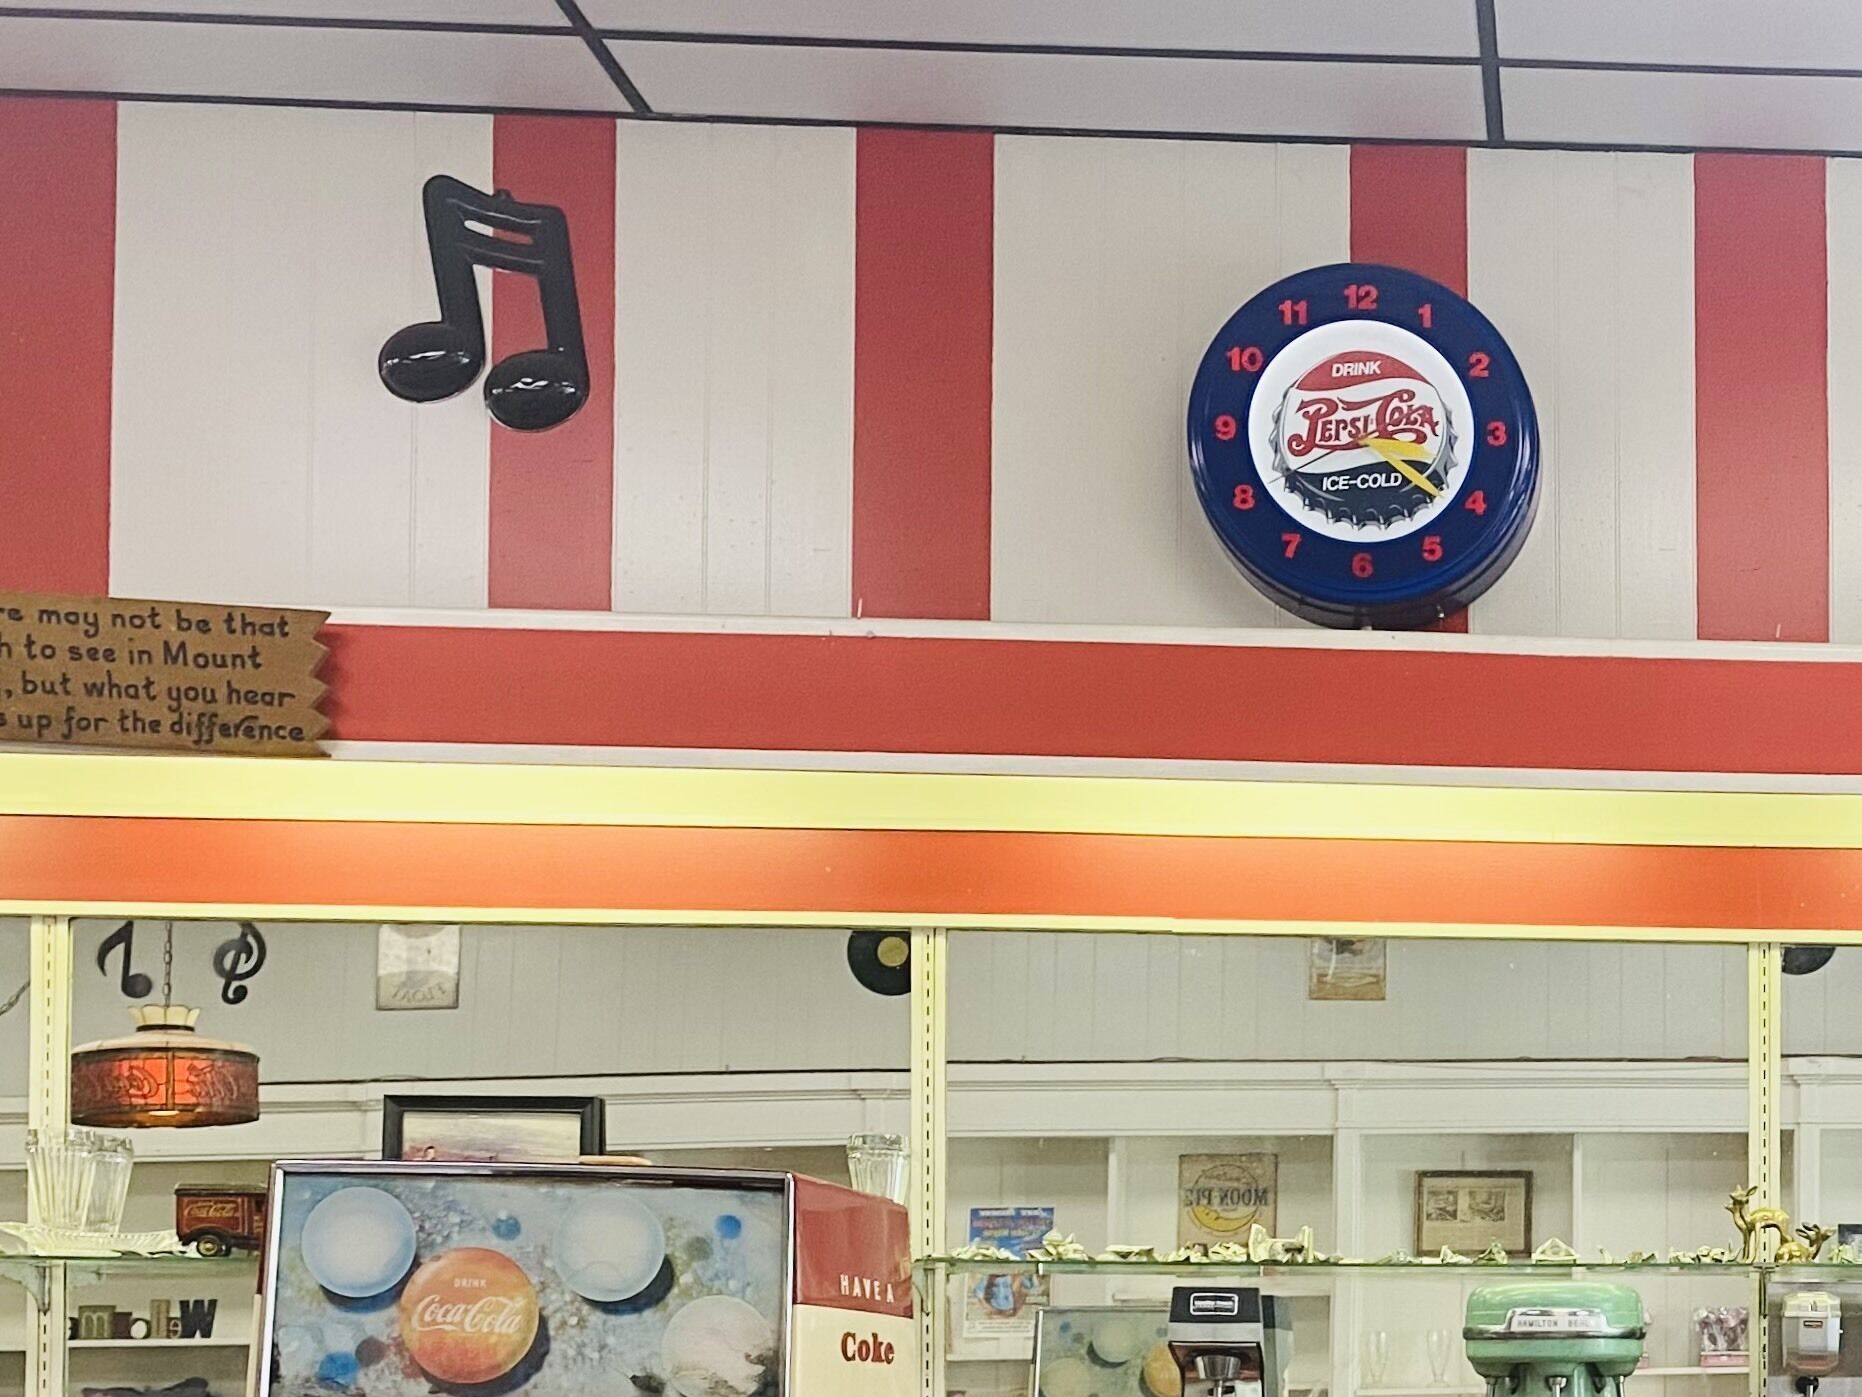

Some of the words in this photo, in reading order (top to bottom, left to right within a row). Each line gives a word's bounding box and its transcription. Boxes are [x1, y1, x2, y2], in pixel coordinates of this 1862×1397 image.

[1344, 284, 1378, 310] 12
[1279, 300, 1307, 325] 11
[1418, 304, 1433, 328] 1
[1227, 347, 1264, 371] 10
[1331, 361, 1381, 377] DRINK
[1468, 353, 1490, 378] 2
[1214, 415, 1237, 440] 9
[1487, 422, 1508, 446] 3
[1322, 473, 1402, 491] ICE-COLD
[1233, 484, 1255, 510] 8
[1464, 491, 1486, 515] 4
[1281, 534, 1302, 558] 7
[1421, 536, 1443, 561] 5
[1352, 553, 1374, 578] 6
[38, 609, 99, 639] may
[111, 606, 161, 629] not
[176, 609, 212, 632] be
[223, 612, 289, 637] that
[24, 633, 56, 660] to
[68, 645, 117, 663] see
[128, 638, 152, 665] in
[163, 640, 262, 669] Mount
[22, 670, 72, 696] but
[83, 670, 156, 700] what
[168, 686, 217, 713] you
[227, 680, 296, 708] hear
[17, 714, 51, 738] up
[62, 705, 110, 740] for
[119, 709, 161, 735] the
[170, 712, 305, 743] difference
[453, 1278, 488, 1289] DRINK
[840, 1274, 882, 1301] HAVE
[887, 1283, 895, 1303] A
[1517, 1319, 1558, 1328] HAMILTON
[840, 1331, 895, 1365] Coke
